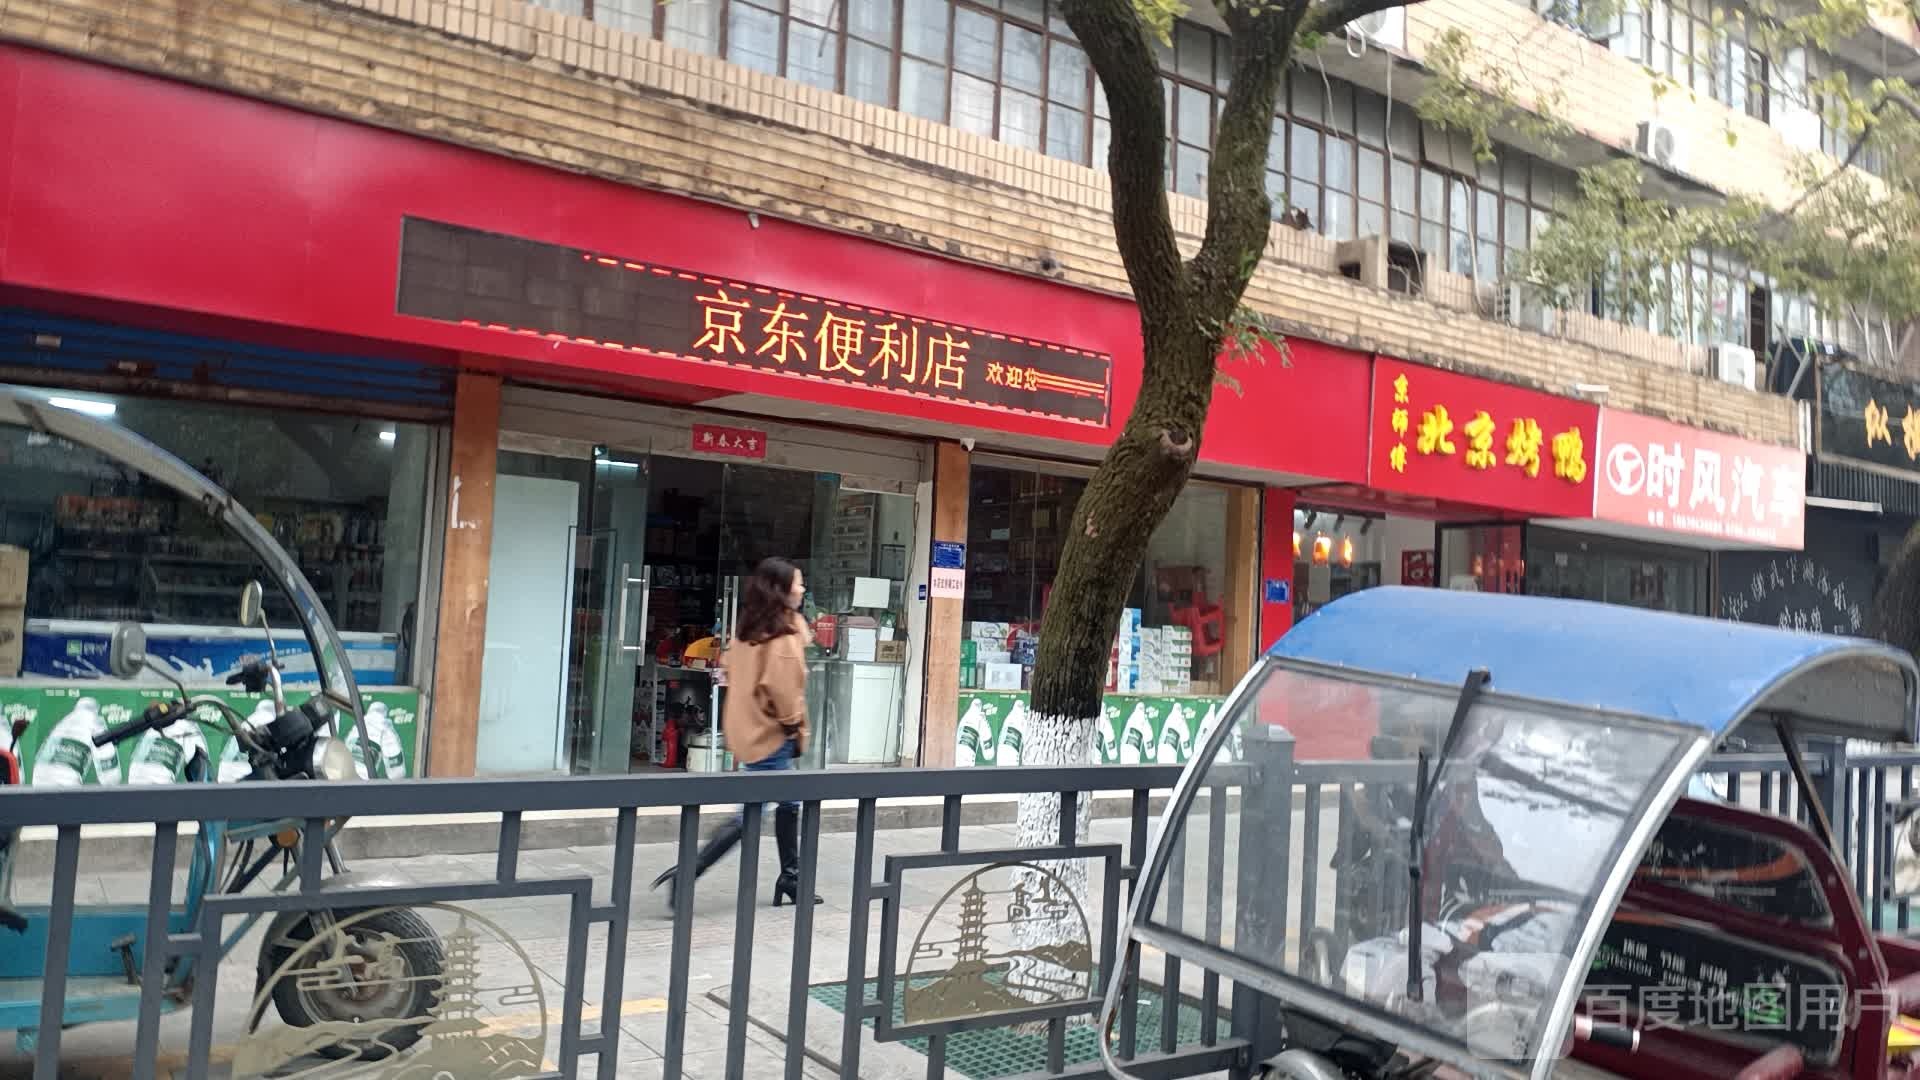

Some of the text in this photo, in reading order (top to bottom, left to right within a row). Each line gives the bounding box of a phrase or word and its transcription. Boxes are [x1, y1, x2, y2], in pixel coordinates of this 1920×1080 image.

[693, 289, 971, 391] 京东便利店
[702, 431, 758, 451] 新春大吉
[1417, 403, 1587, 484] 北京烤鸭
[1647, 441, 1801, 528] 时风汽车
